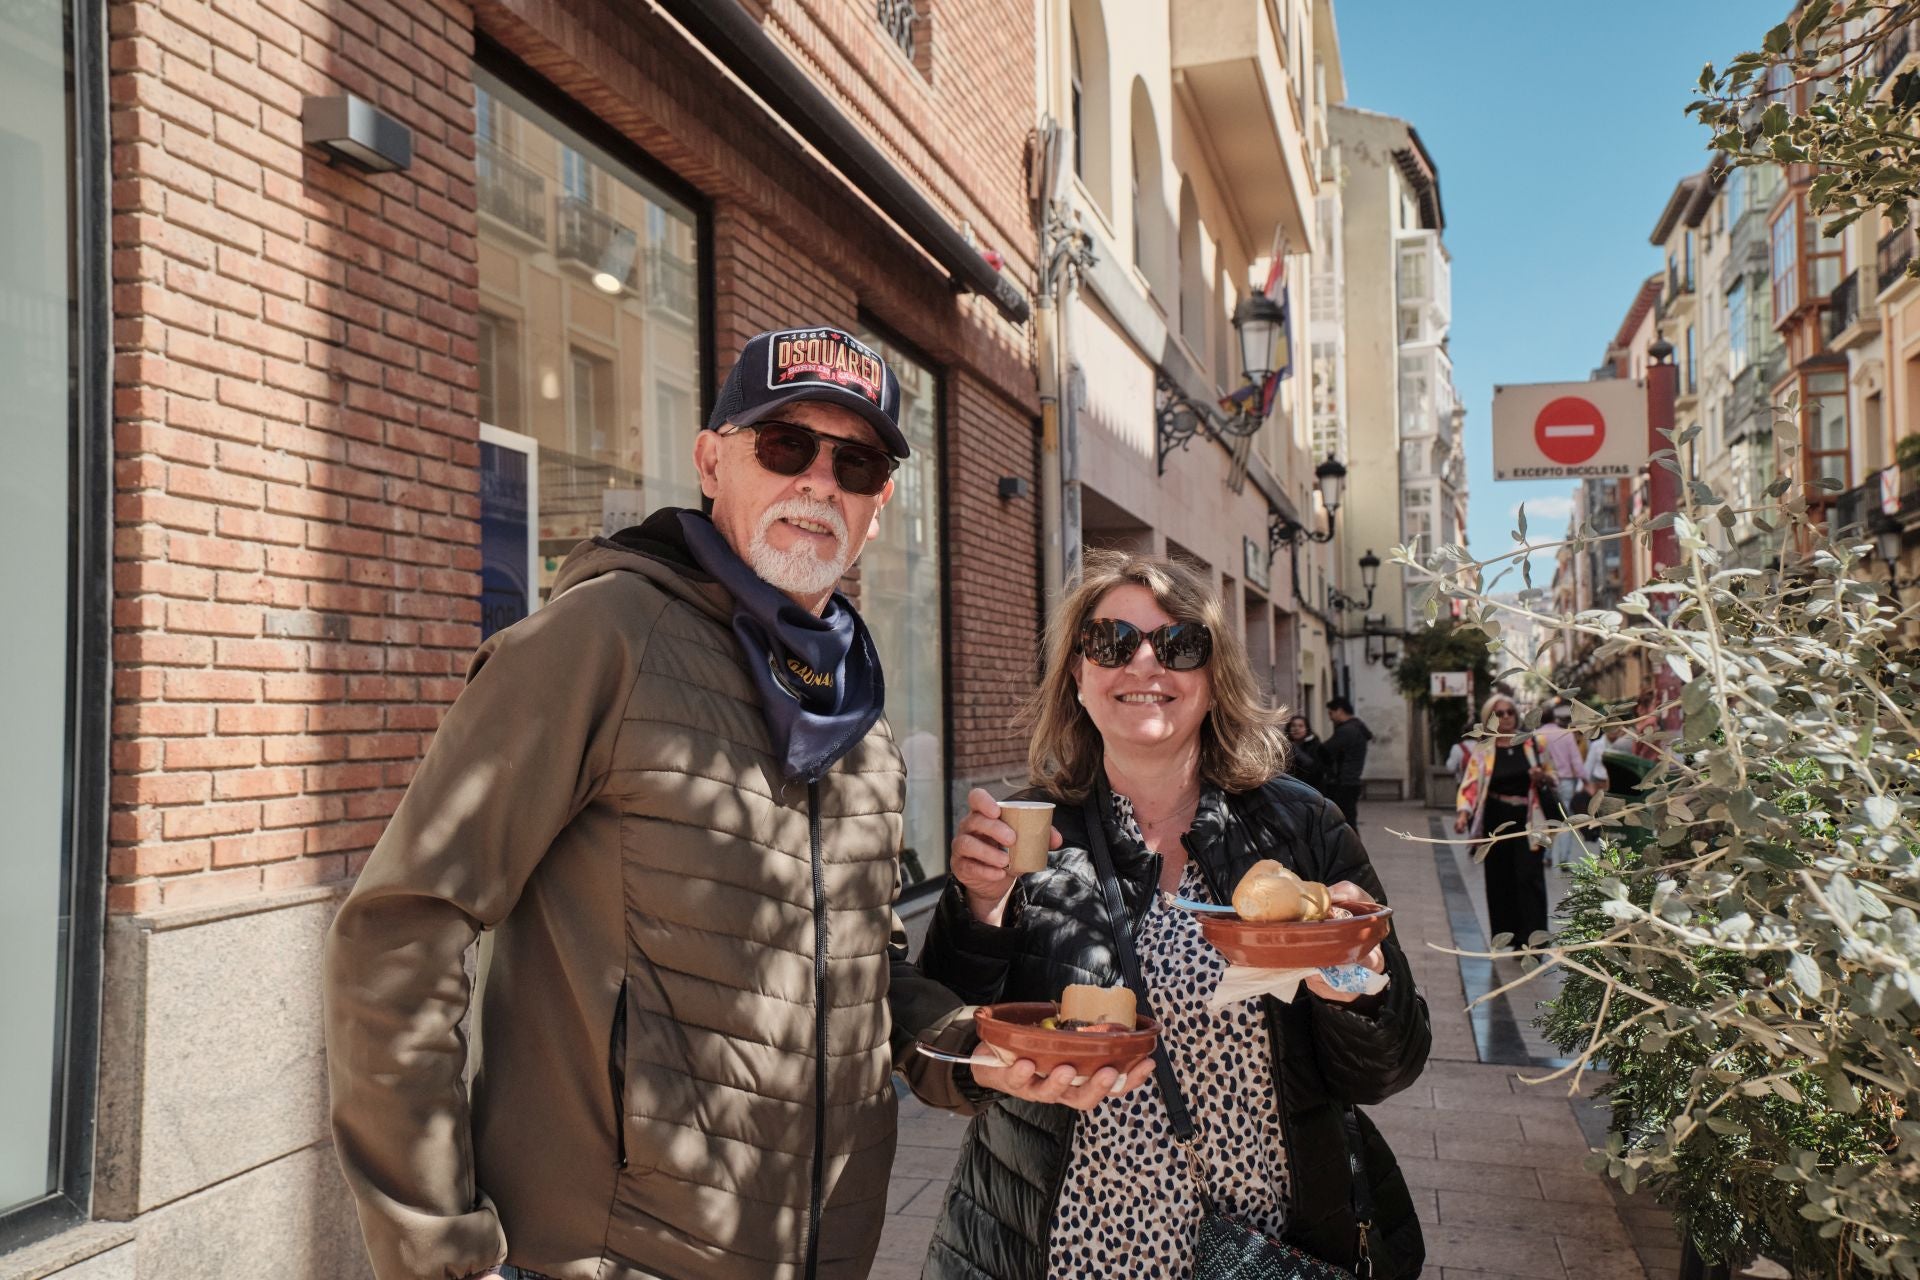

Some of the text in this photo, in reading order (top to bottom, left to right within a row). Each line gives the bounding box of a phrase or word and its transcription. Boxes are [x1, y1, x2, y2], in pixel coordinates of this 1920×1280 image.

[778, 339, 881, 389] DSQUARED
[1513, 465, 1630, 477] EXCEPTO BICICLETAS
